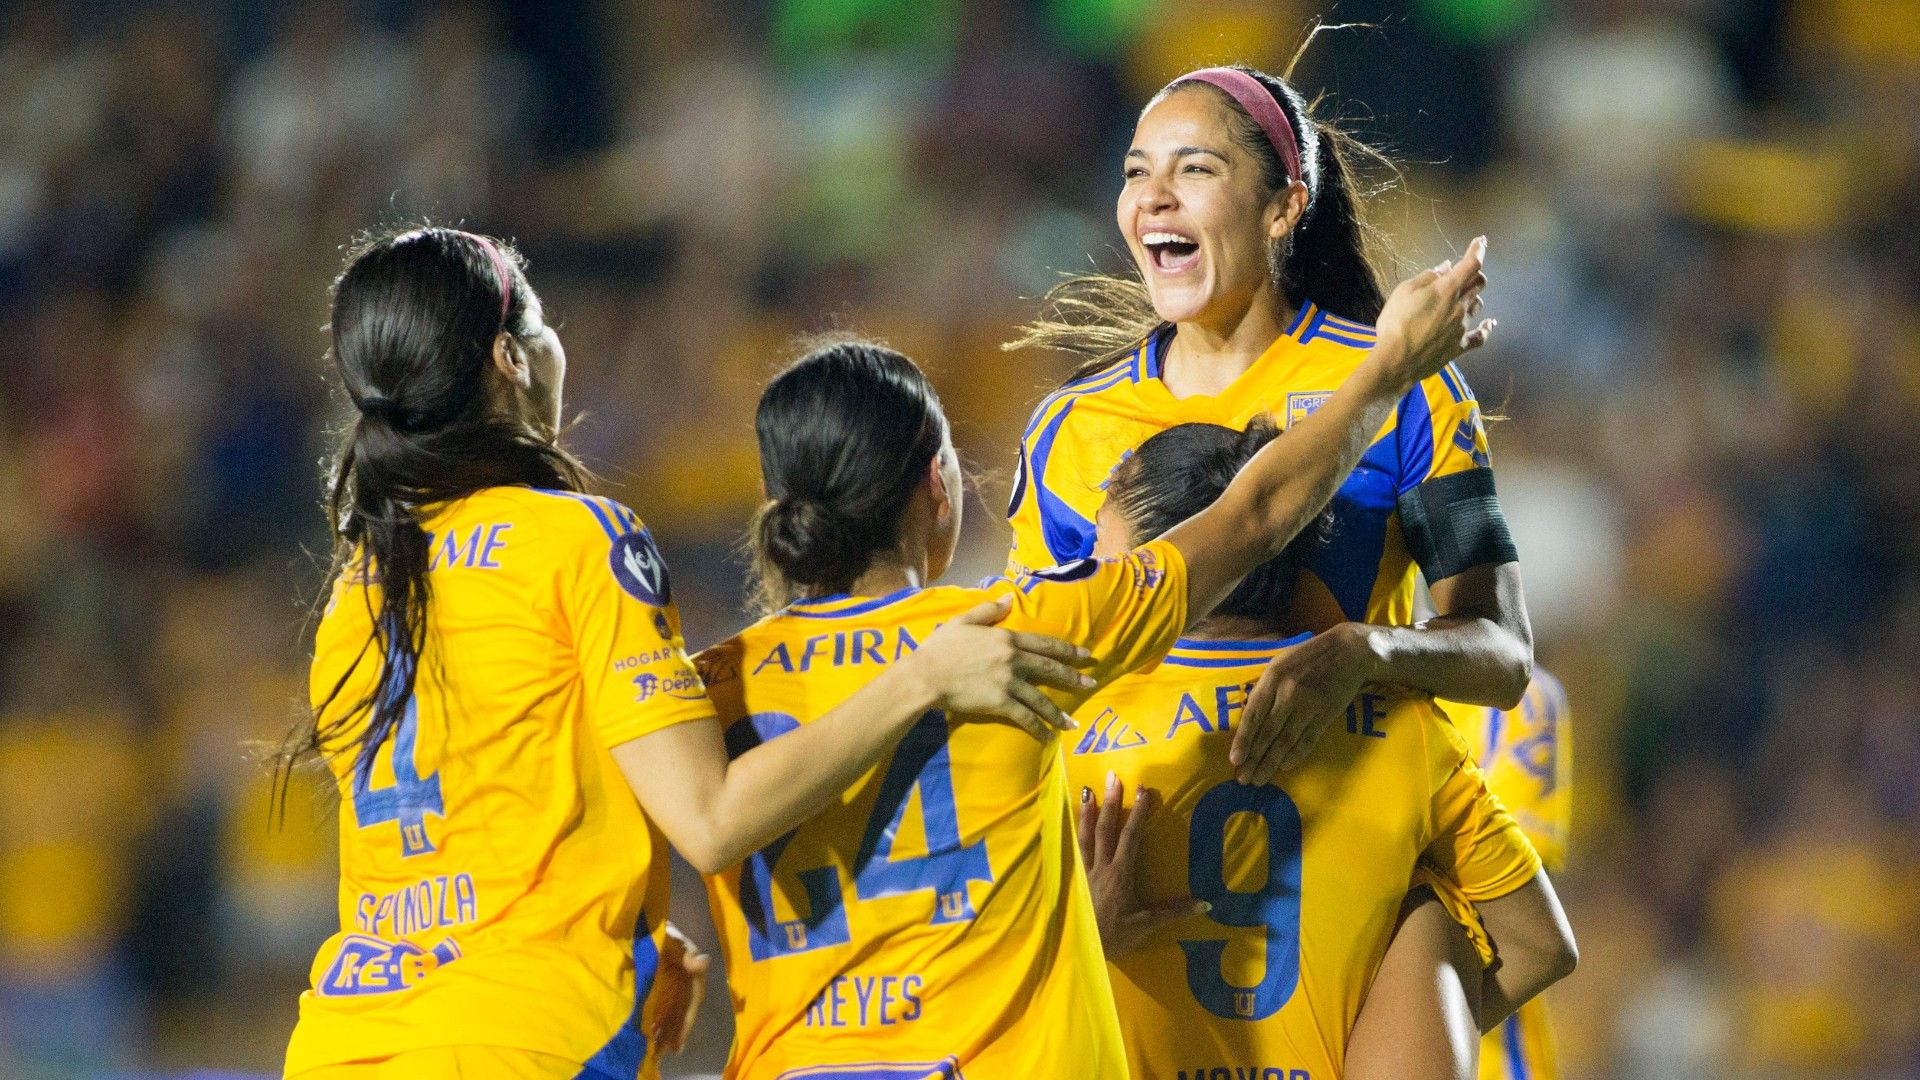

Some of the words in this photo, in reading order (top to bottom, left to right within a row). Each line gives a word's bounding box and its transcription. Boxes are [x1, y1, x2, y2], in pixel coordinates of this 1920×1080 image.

[1293, 397, 1330, 410] TIGRE
[352, 612, 447, 861] 4
[1176, 778, 1303, 1022] 9
[803, 974, 924, 1028] REYES
